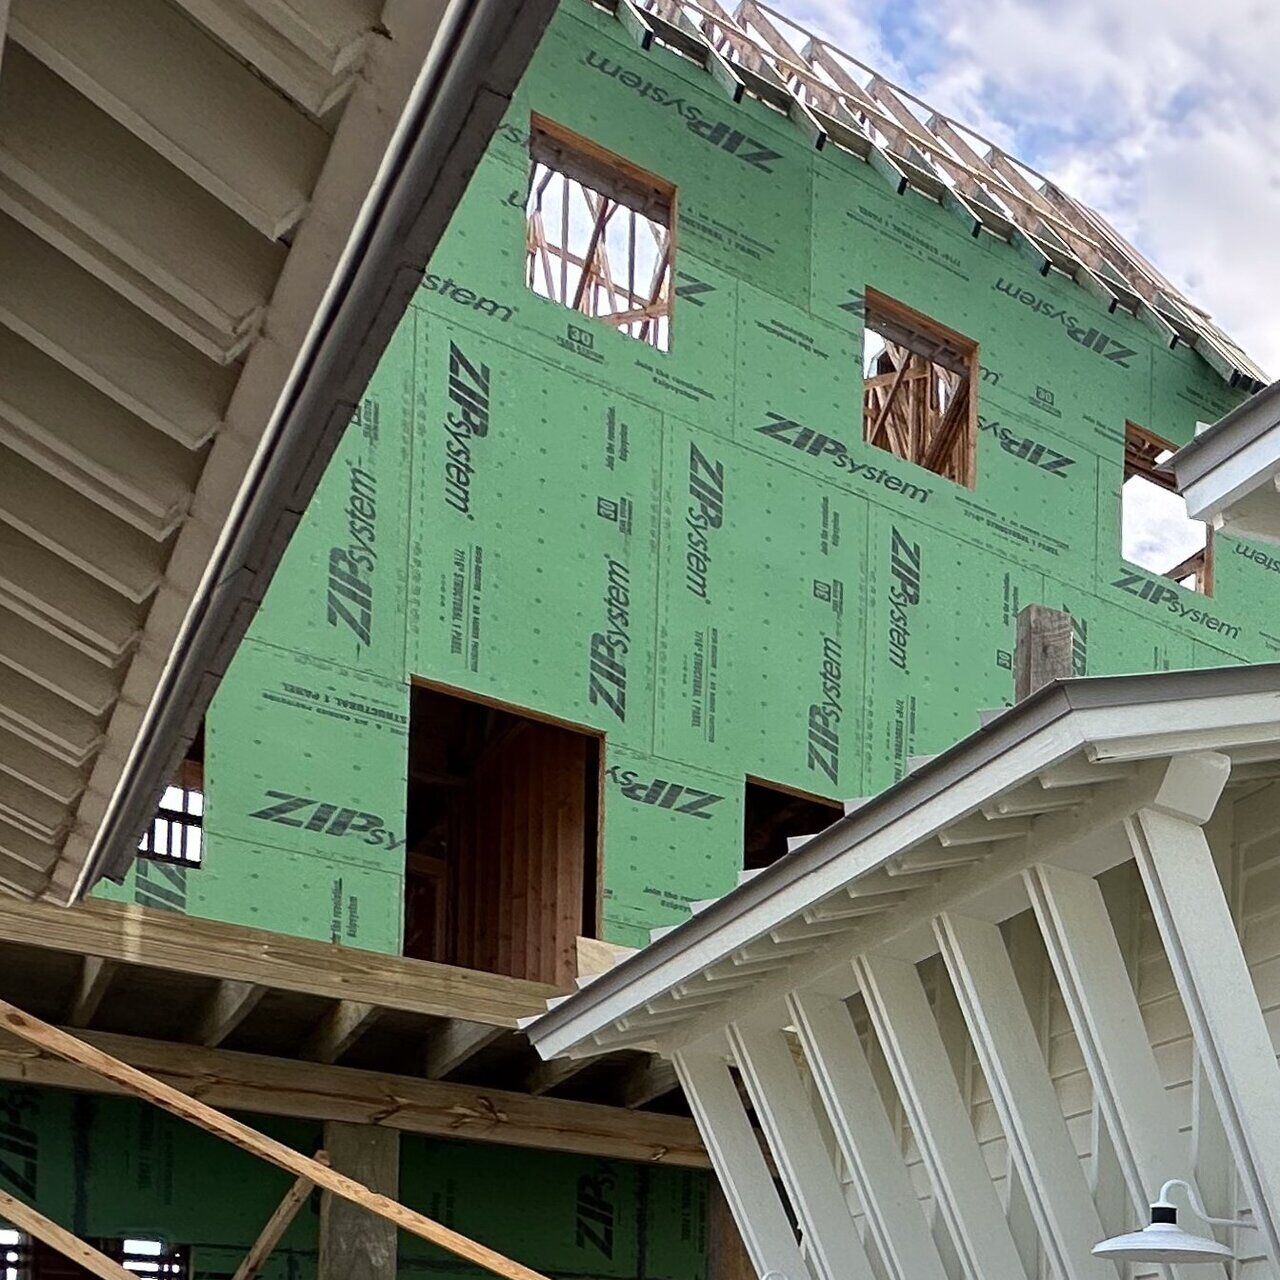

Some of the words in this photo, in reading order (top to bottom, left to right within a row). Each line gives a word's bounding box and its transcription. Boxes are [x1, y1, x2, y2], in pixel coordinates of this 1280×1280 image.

[582, 50, 785, 174] ZIPsystem
[566, 326, 593, 346] 30
[994, 276, 1138, 368] ZIPsystem
[444, 340, 491, 521] ZIPsystem
[754, 412, 934, 504] ZIPsystem
[327, 458, 378, 647] ZIPsystem
[600, 500, 615, 519] 30
[686, 442, 725, 605] ZIPsystem
[589, 554, 632, 723] ZIPsystem
[815, 583, 829, 600] 30
[890, 525, 922, 675] ZIPsystem
[1111, 567, 1242, 640] ZIPsystem
[331, 695, 408, 724] STRUCTURAL
[806, 631, 844, 786] ZIPsystem
